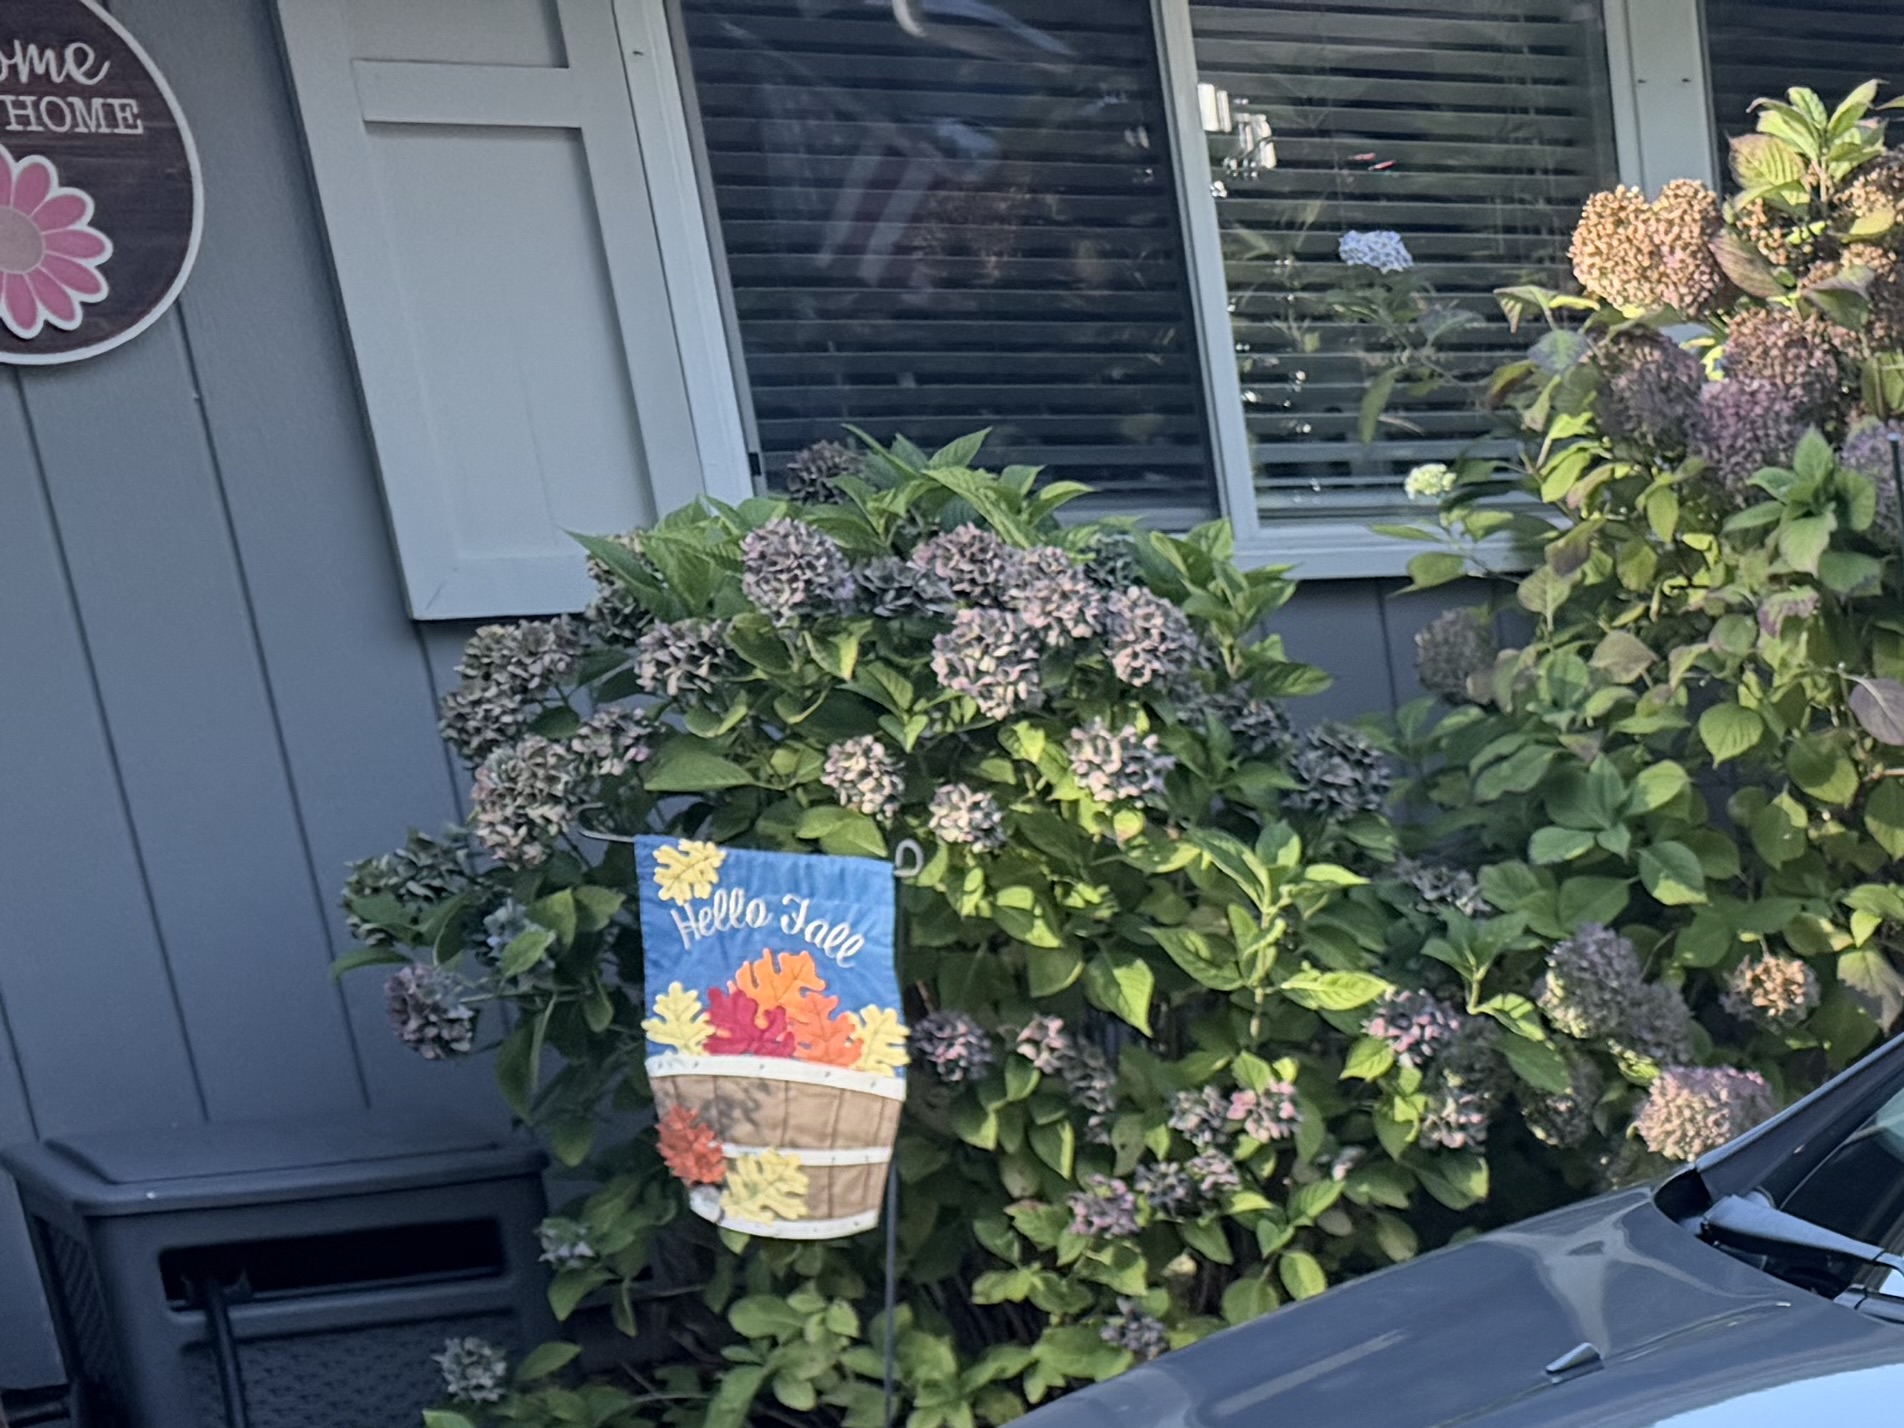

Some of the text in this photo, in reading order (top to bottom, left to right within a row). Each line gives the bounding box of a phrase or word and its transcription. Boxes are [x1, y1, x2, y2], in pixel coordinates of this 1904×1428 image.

[0, 95, 145, 134] HOME
[670, 888, 866, 968] Hello Fall
